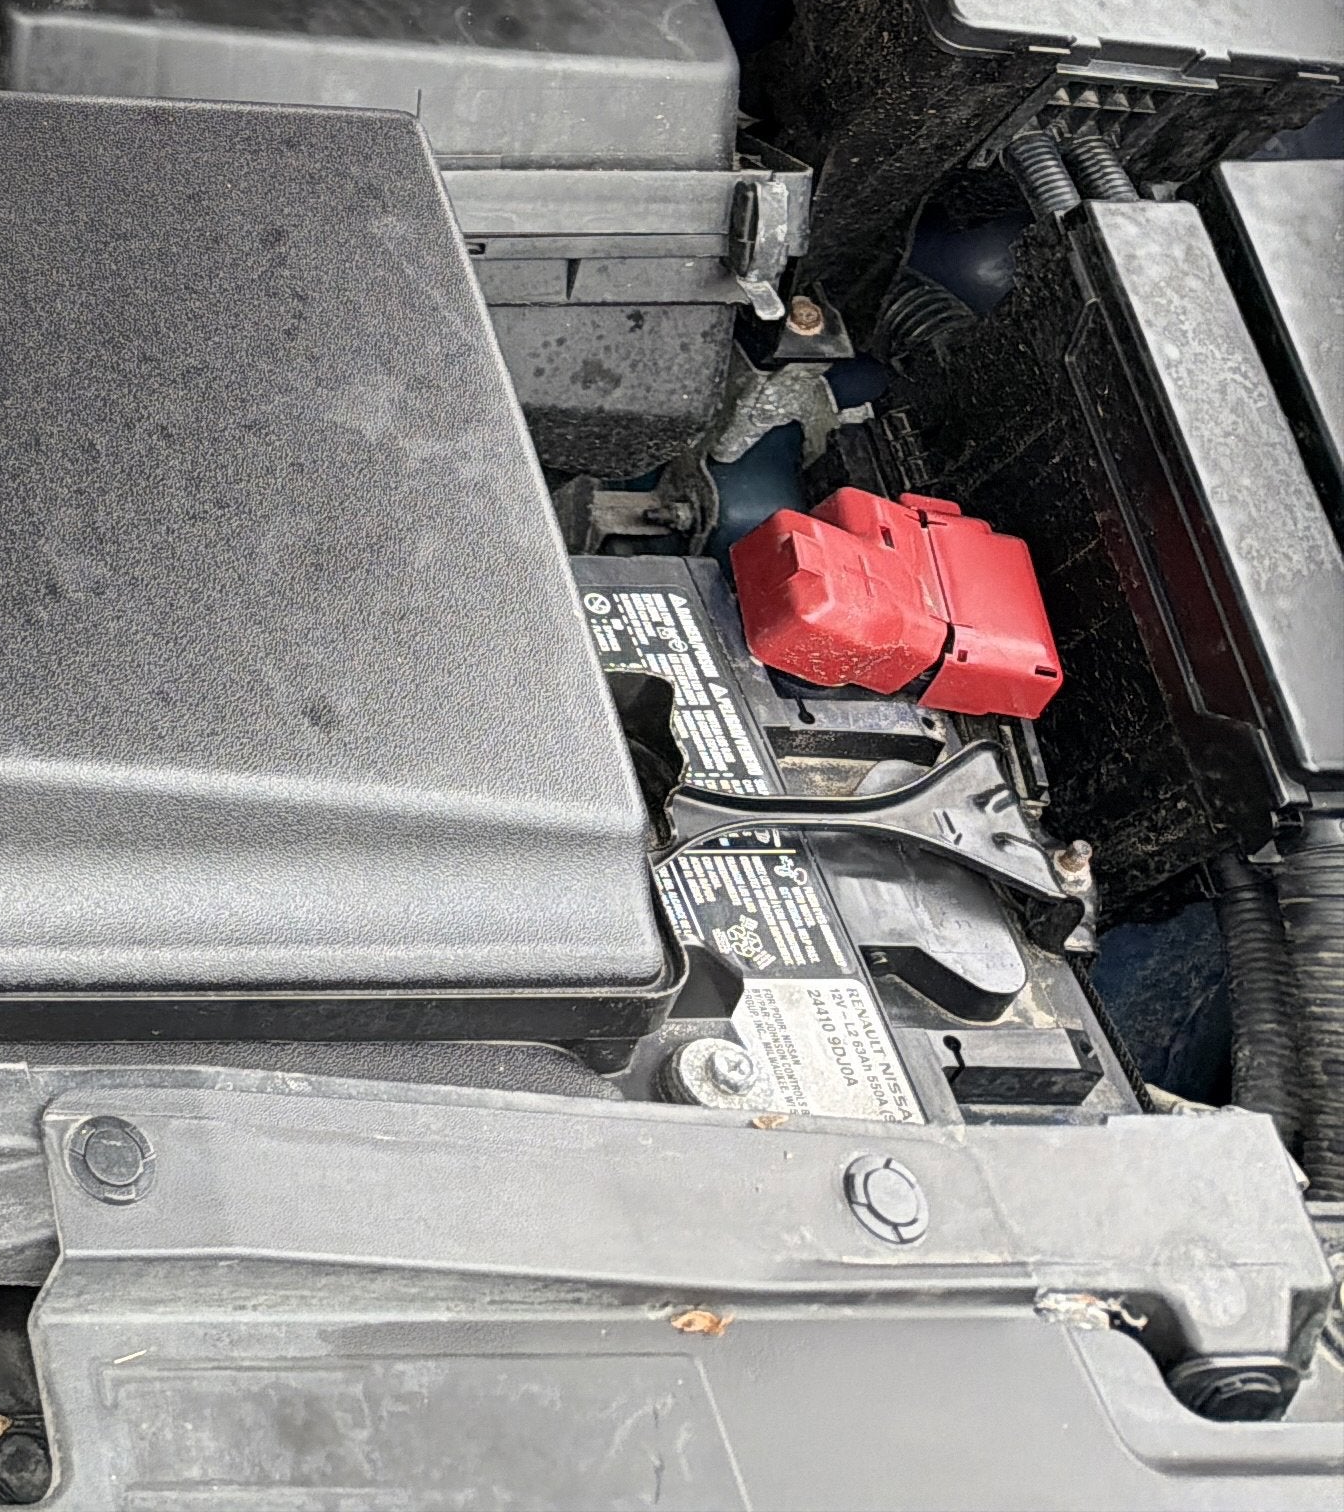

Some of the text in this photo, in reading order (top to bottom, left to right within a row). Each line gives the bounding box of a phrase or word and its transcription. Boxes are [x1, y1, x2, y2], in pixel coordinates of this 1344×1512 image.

[828, 988, 847, 1008] 12V
[805, 989, 860, 1086] 24410 9DJ0A
[843, 1022, 860, 1036] L2
[764, 1022, 788, 1060] JOHNSON
[780, 1062, 808, 1106] CONTROLS
[780, 1035, 802, 1065] NISSAN
[845, 988, 915, 1122] RENAULT NISSA
[850, 1040, 874, 1071] 63Ah
[866, 1075, 889, 1106] 550A
